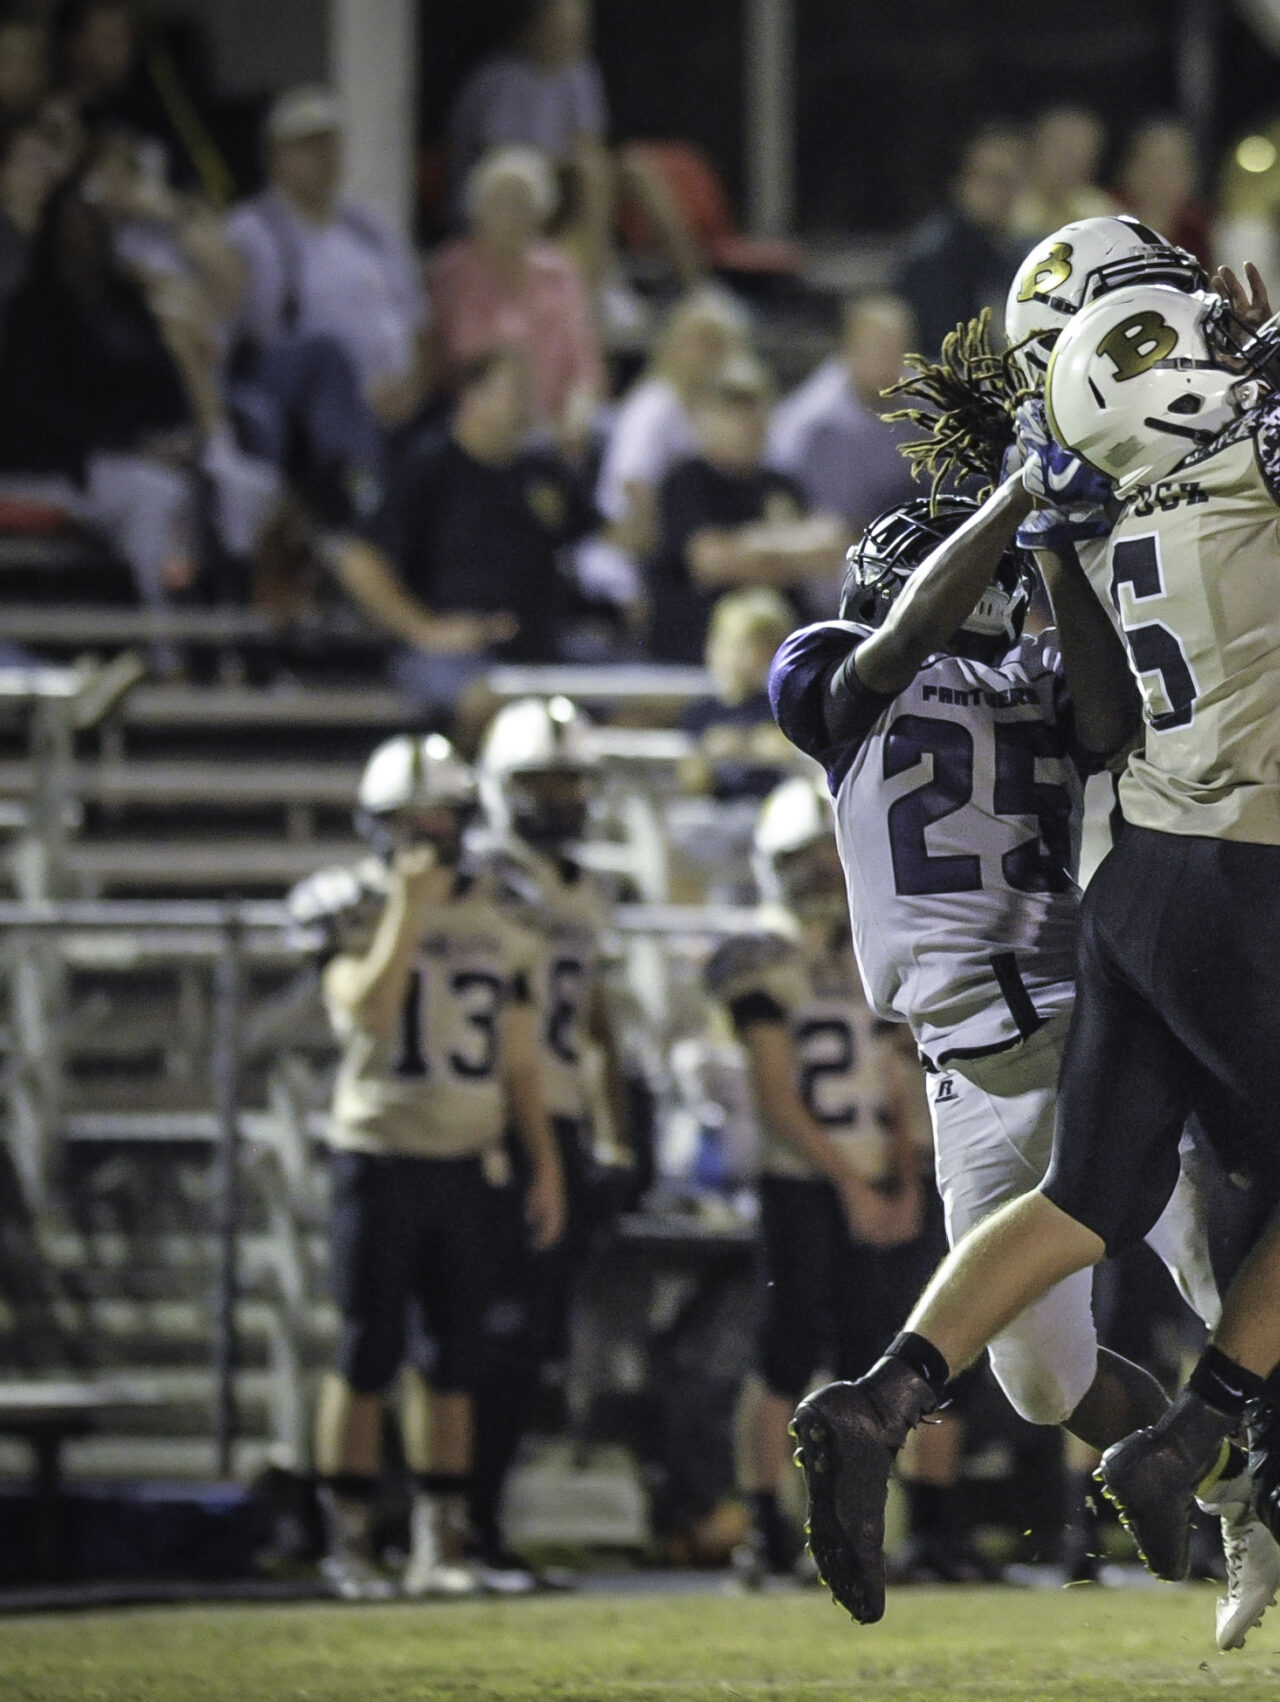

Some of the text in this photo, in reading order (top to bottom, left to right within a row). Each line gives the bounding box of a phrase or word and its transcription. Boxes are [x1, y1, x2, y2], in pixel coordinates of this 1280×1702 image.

[1017, 242, 1074, 302] B
[1096, 310, 1179, 383] B
[882, 713, 1071, 896] 25
[393, 968, 500, 1078] 13
